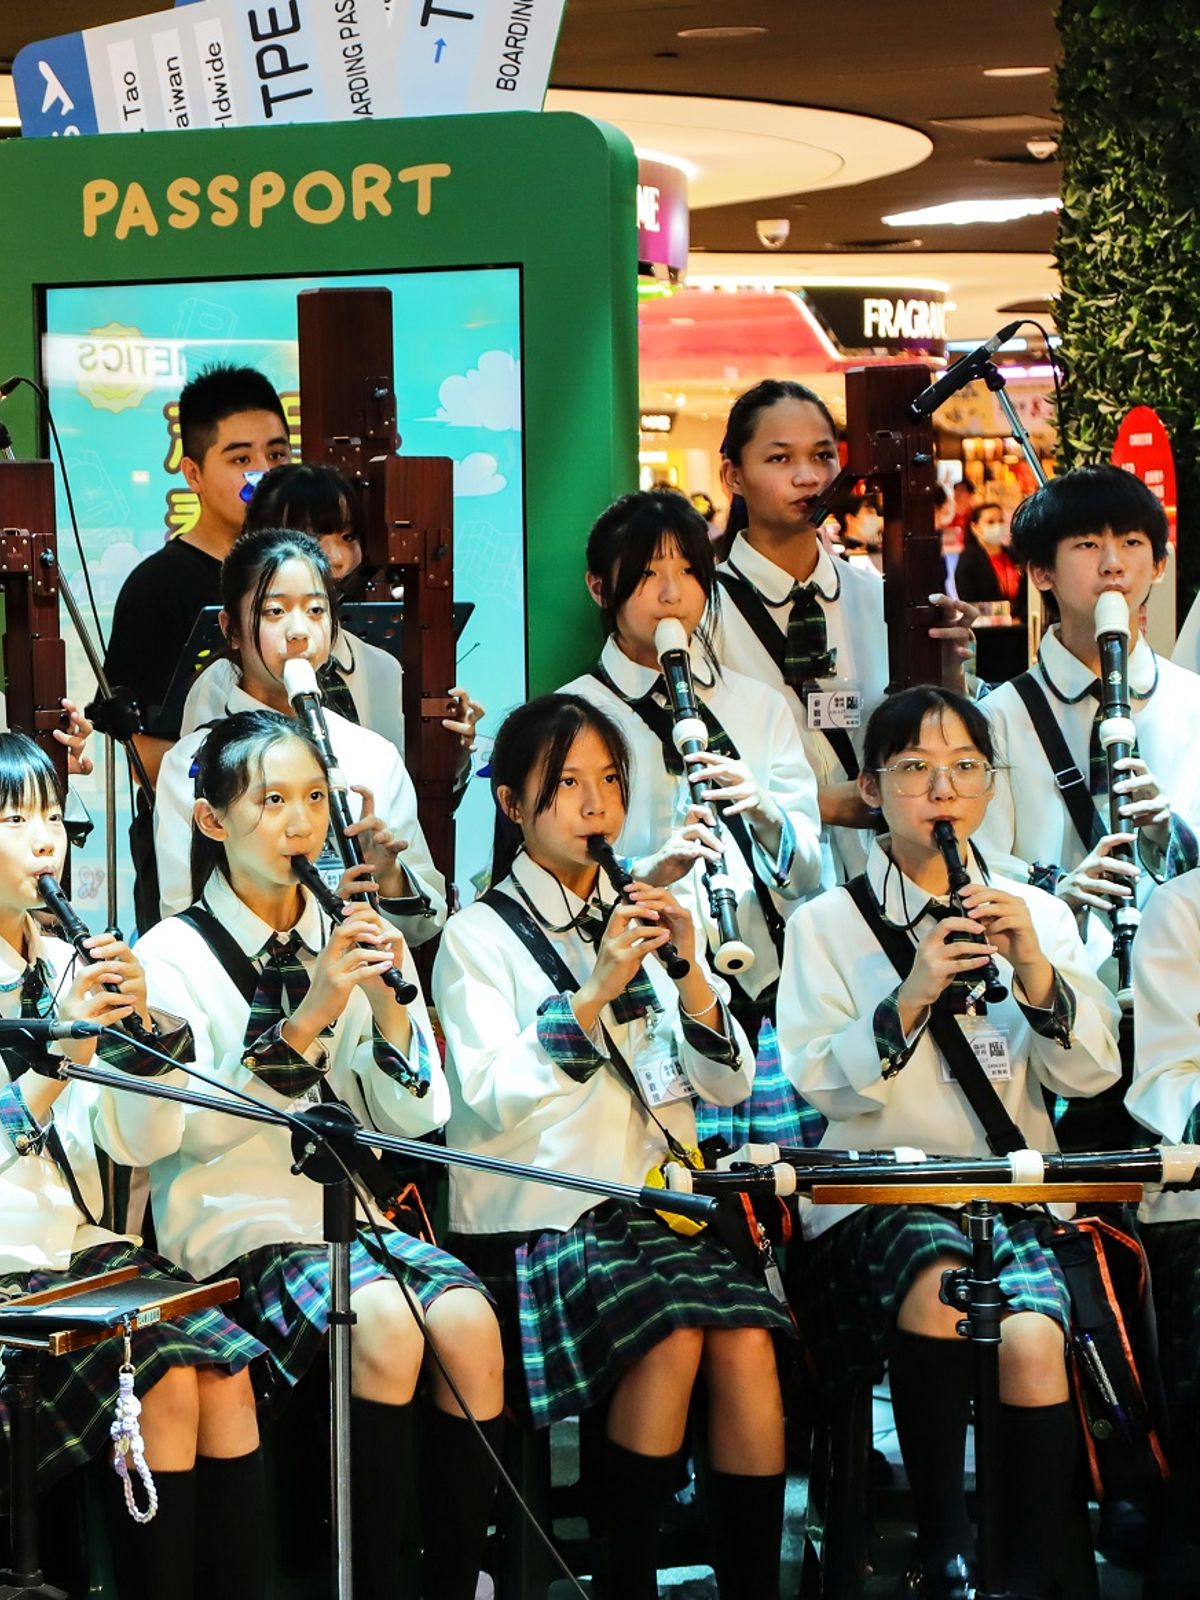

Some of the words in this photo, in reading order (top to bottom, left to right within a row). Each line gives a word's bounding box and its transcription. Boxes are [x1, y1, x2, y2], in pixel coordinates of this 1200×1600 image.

[248, 0, 313, 118] TPE
[343, 43, 374, 120] ARDING
[496, 0, 534, 91] BOARDIN
[123, 71, 142, 122] Tao
[166, 55, 190, 128] aiwan
[205, 41, 233, 128] ldwide
[82, 163, 452, 240] PASSPORT
